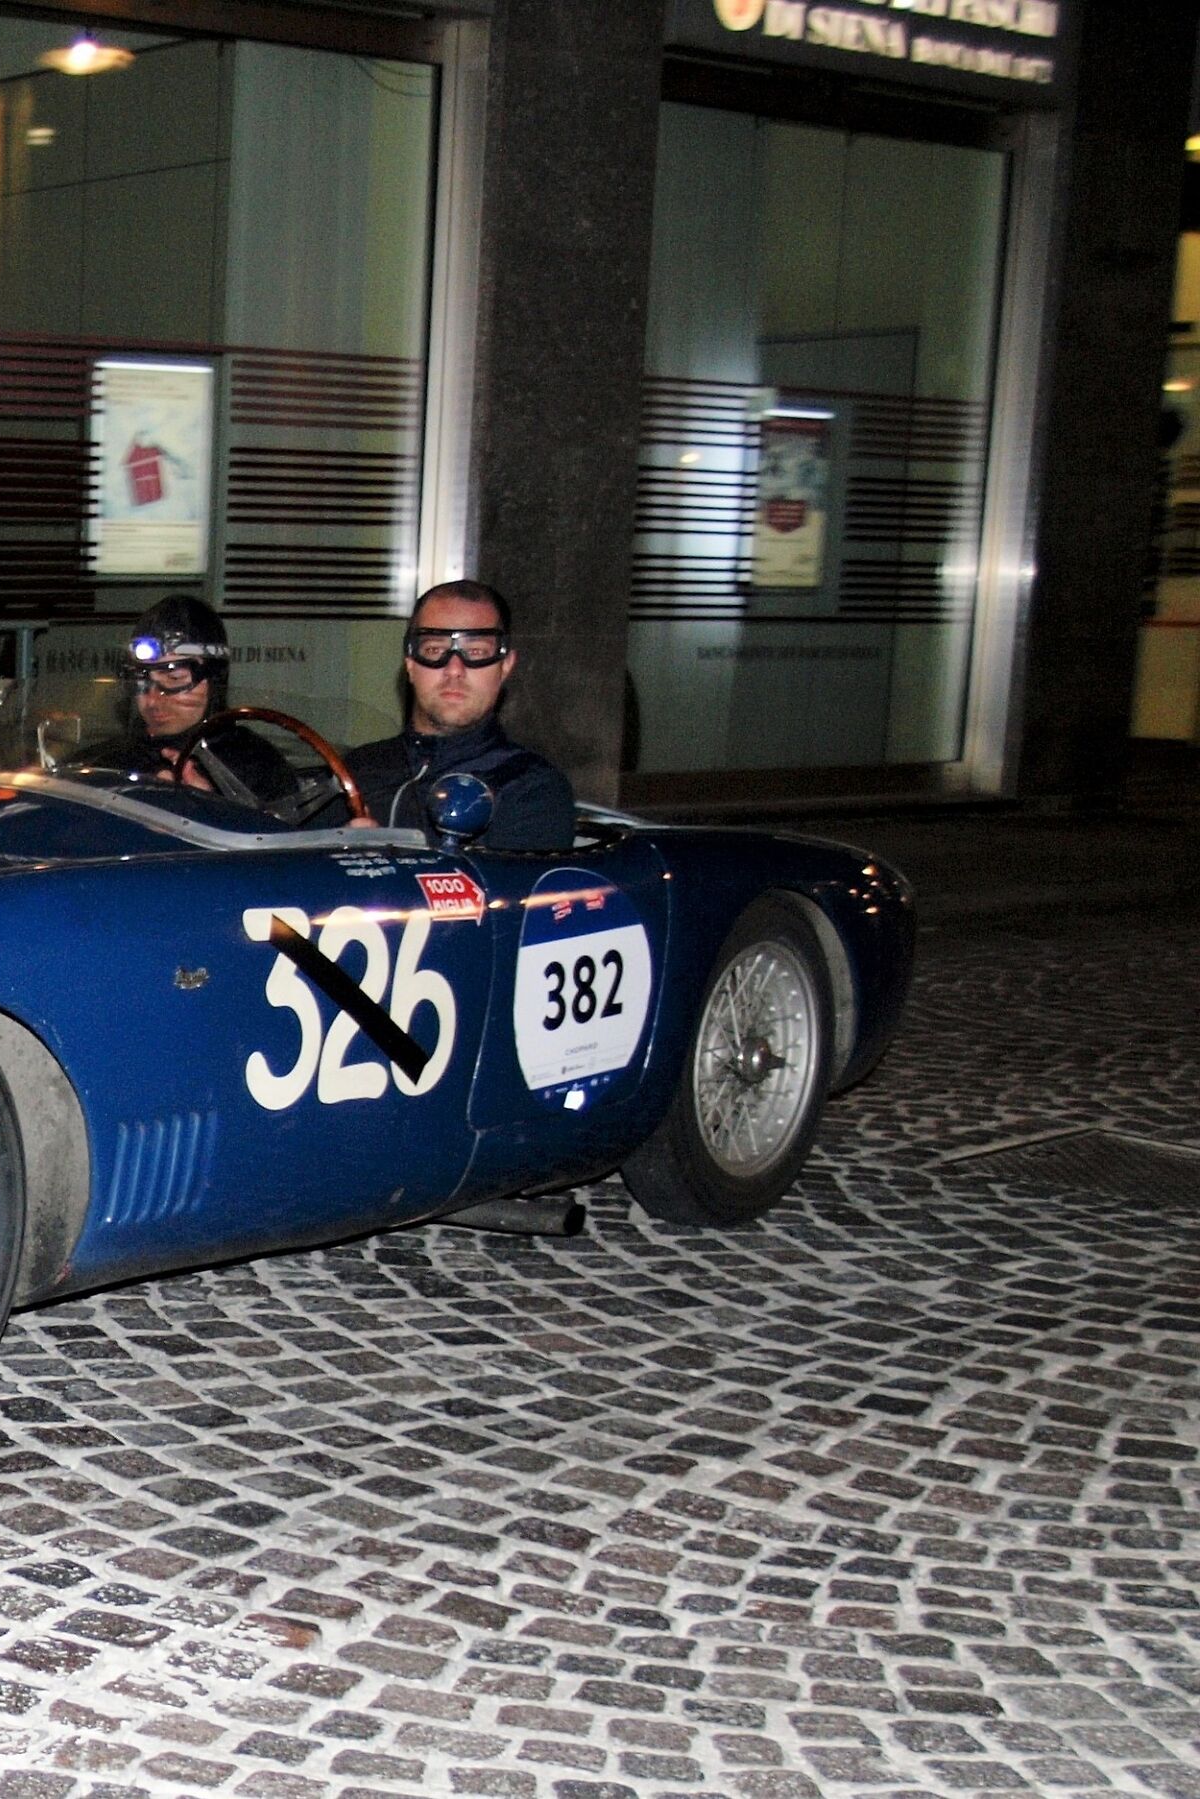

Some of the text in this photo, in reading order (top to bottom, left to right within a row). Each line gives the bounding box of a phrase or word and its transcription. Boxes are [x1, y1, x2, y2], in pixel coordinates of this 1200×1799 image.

[806, 7, 907, 58] SIENA
[425, 878, 465, 894] 1000
[242, 906, 457, 1111] 326
[542, 949, 624, 1031] 382
